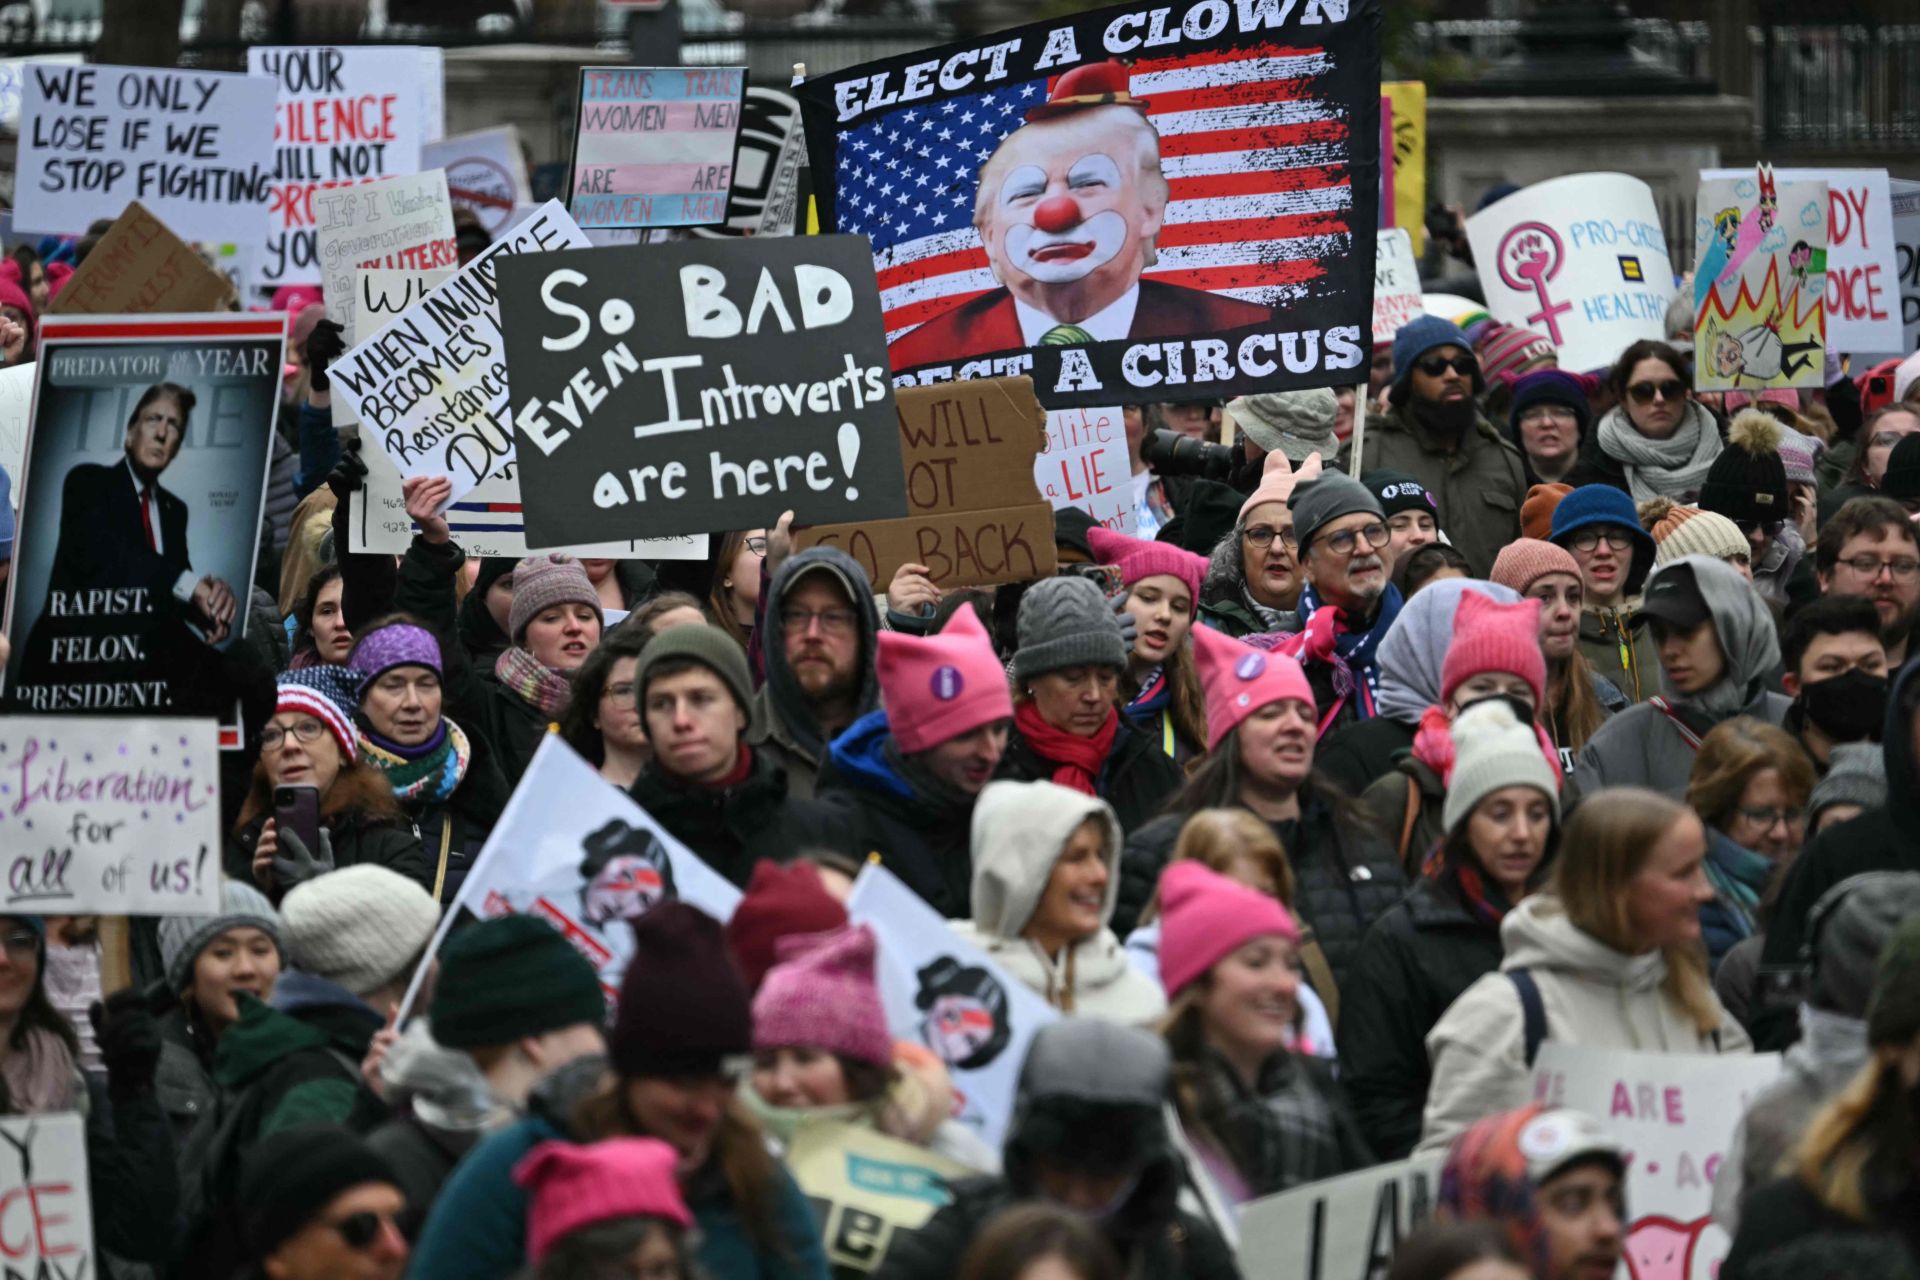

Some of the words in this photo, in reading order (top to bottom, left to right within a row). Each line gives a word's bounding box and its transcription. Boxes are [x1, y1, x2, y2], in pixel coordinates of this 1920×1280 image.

[262, 47, 345, 93] YOUR
[586, 71, 654, 99] TRANS
[685, 70, 740, 98] TRANS
[833, 38, 1022, 123] ELECT
[1034, 26, 1082, 70] A
[1103, 0, 1350, 54] CLOWN
[35, 67, 97, 107] WE
[118, 73, 221, 114] ONLY
[33, 114, 109, 150] LOSE
[122, 118, 150, 150] IF
[166, 123, 220, 158] WE
[584, 104, 667, 131] WOMEN
[694, 103, 739, 129] MEN
[40, 158, 126, 193] STOP
[137, 161, 273, 204] FIGHTING
[331, 143, 386, 177] NOT
[578, 168, 616, 194] ARE
[692, 165, 730, 191] ARE
[364, 191, 381, 222] I
[571, 197, 653, 225] WOMEN
[681, 194, 727, 222] MEN
[540, 268, 635, 352] So
[680, 263, 854, 338] BAD
[51, 354, 161, 378] PREDATOR
[195, 348, 269, 377] YEAR
[333, 317, 429, 397] WHEN
[361, 324, 492, 430] BECOMES
[1053, 349, 1102, 393] A
[1121, 324, 1364, 389] CIRCUS
[54, 383, 250, 450] TIE
[385, 362, 509, 466] Resistance
[515, 341, 640, 457] EVEN
[634, 354, 886, 438] Introverts
[897, 397, 1004, 448] WILL
[592, 461, 688, 508] are
[710, 422, 861, 502] here!
[1046, 484, 1059, 497] a
[1061, 449, 1112, 501] LIE
[383, 522, 408, 533] 92%
[916, 522, 1038, 583] BACK
[50, 587, 153, 617] RAPIST.
[50, 635, 146, 664] FELON.
[8, 737, 206, 816] Liberation
[8, 848, 74, 896] all
[102, 855, 136, 893] of
[150, 843, 208, 896] us!
[1610, 1079, 1685, 1124] ARE
